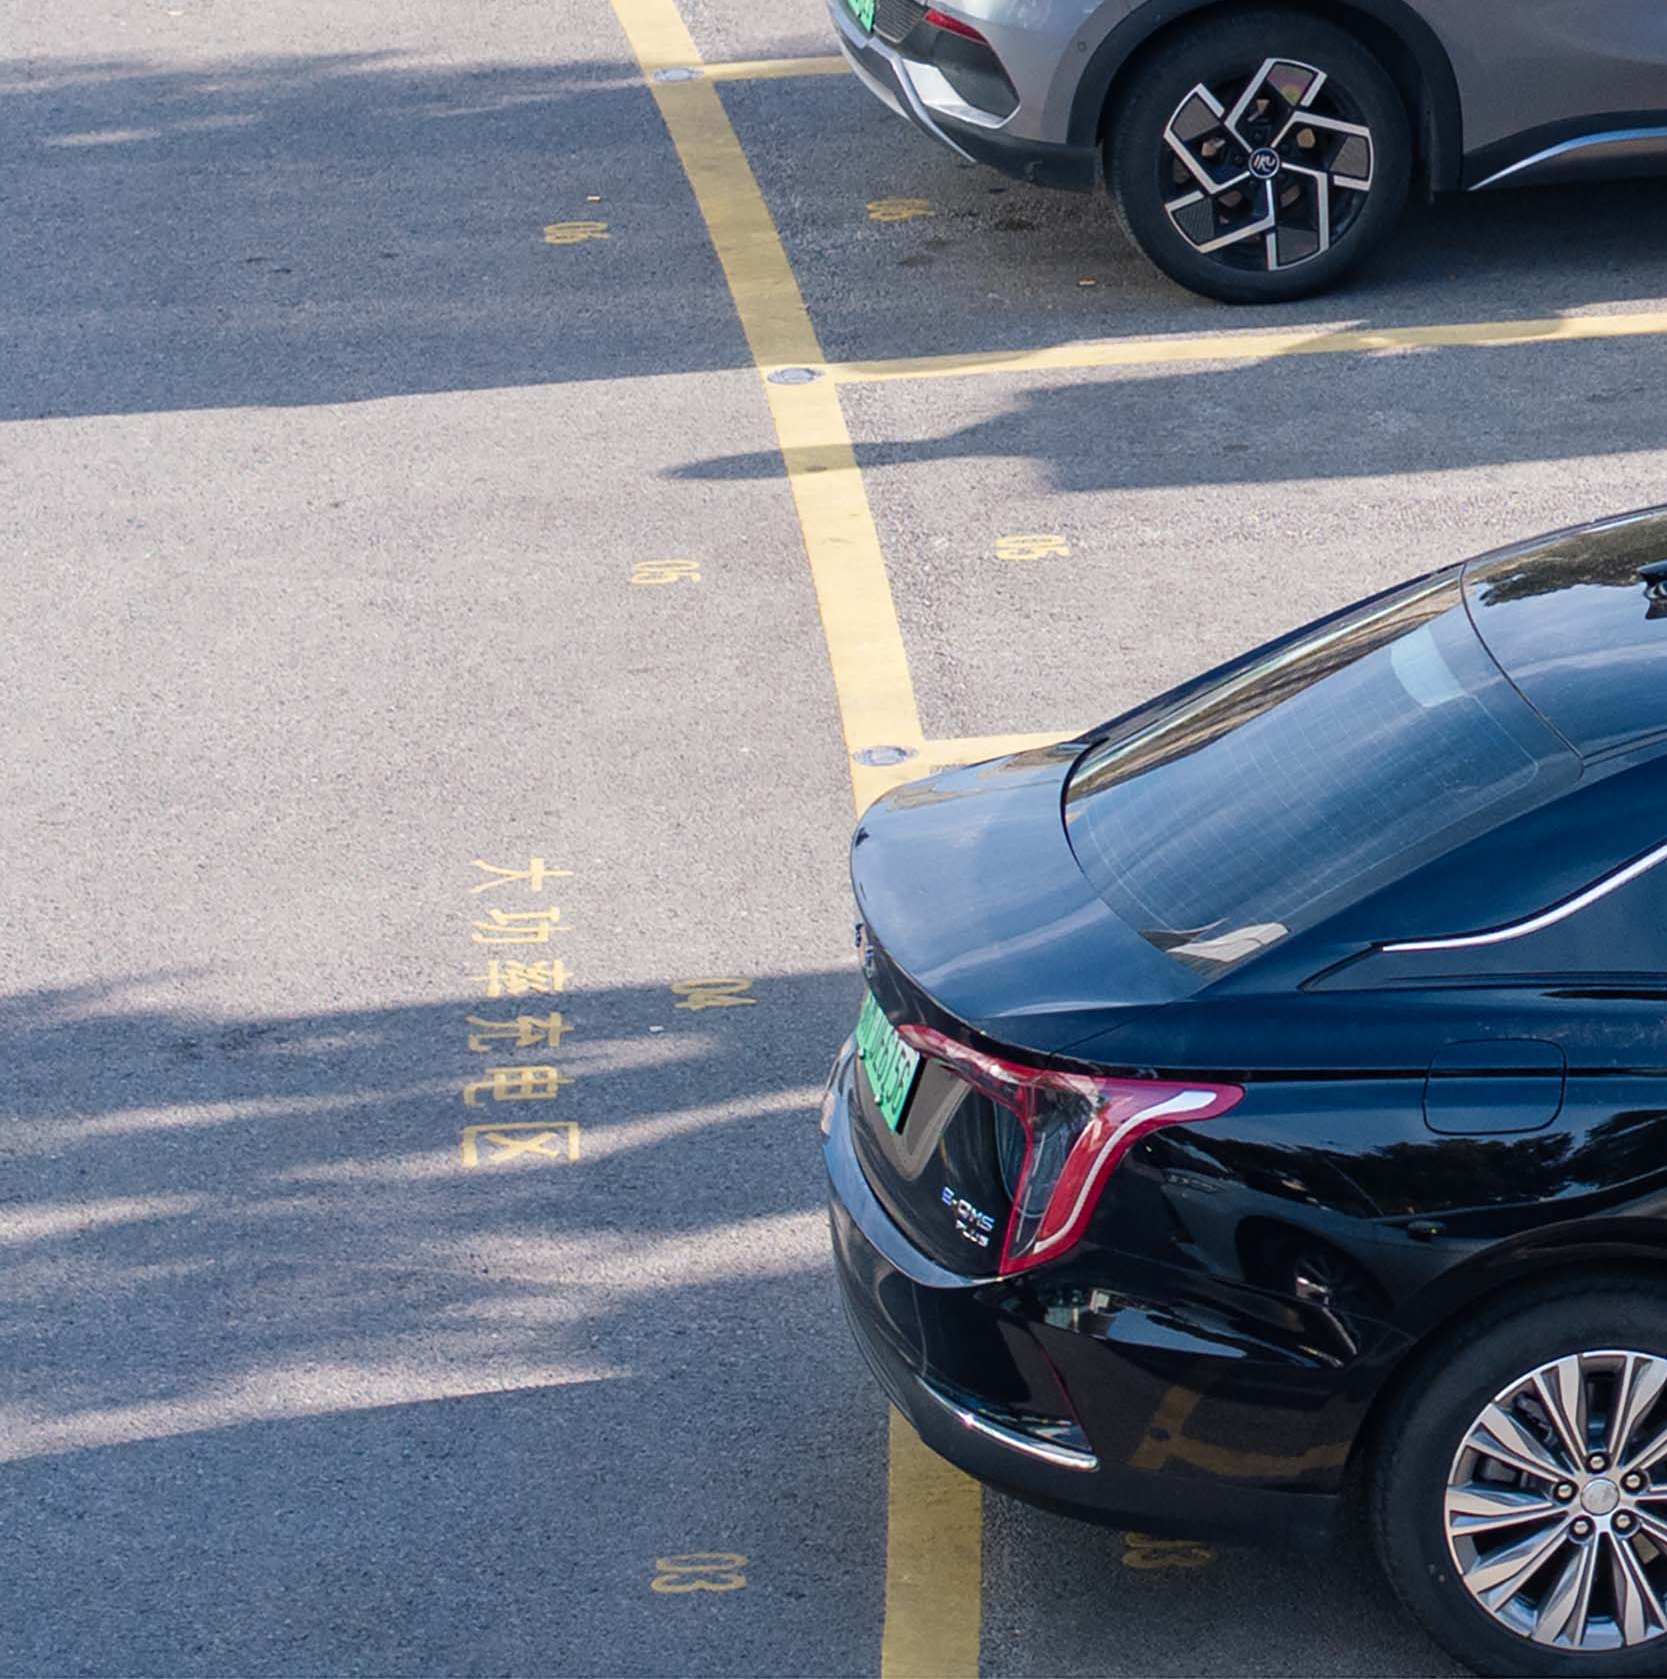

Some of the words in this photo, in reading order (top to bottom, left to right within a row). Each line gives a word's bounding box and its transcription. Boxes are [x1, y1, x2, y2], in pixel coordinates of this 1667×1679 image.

[630, 559, 702, 585] 05
[458, 856, 581, 1169] 大功率充电区
[671, 977, 758, 1010] 04
[650, 1551, 749, 1594] 03
